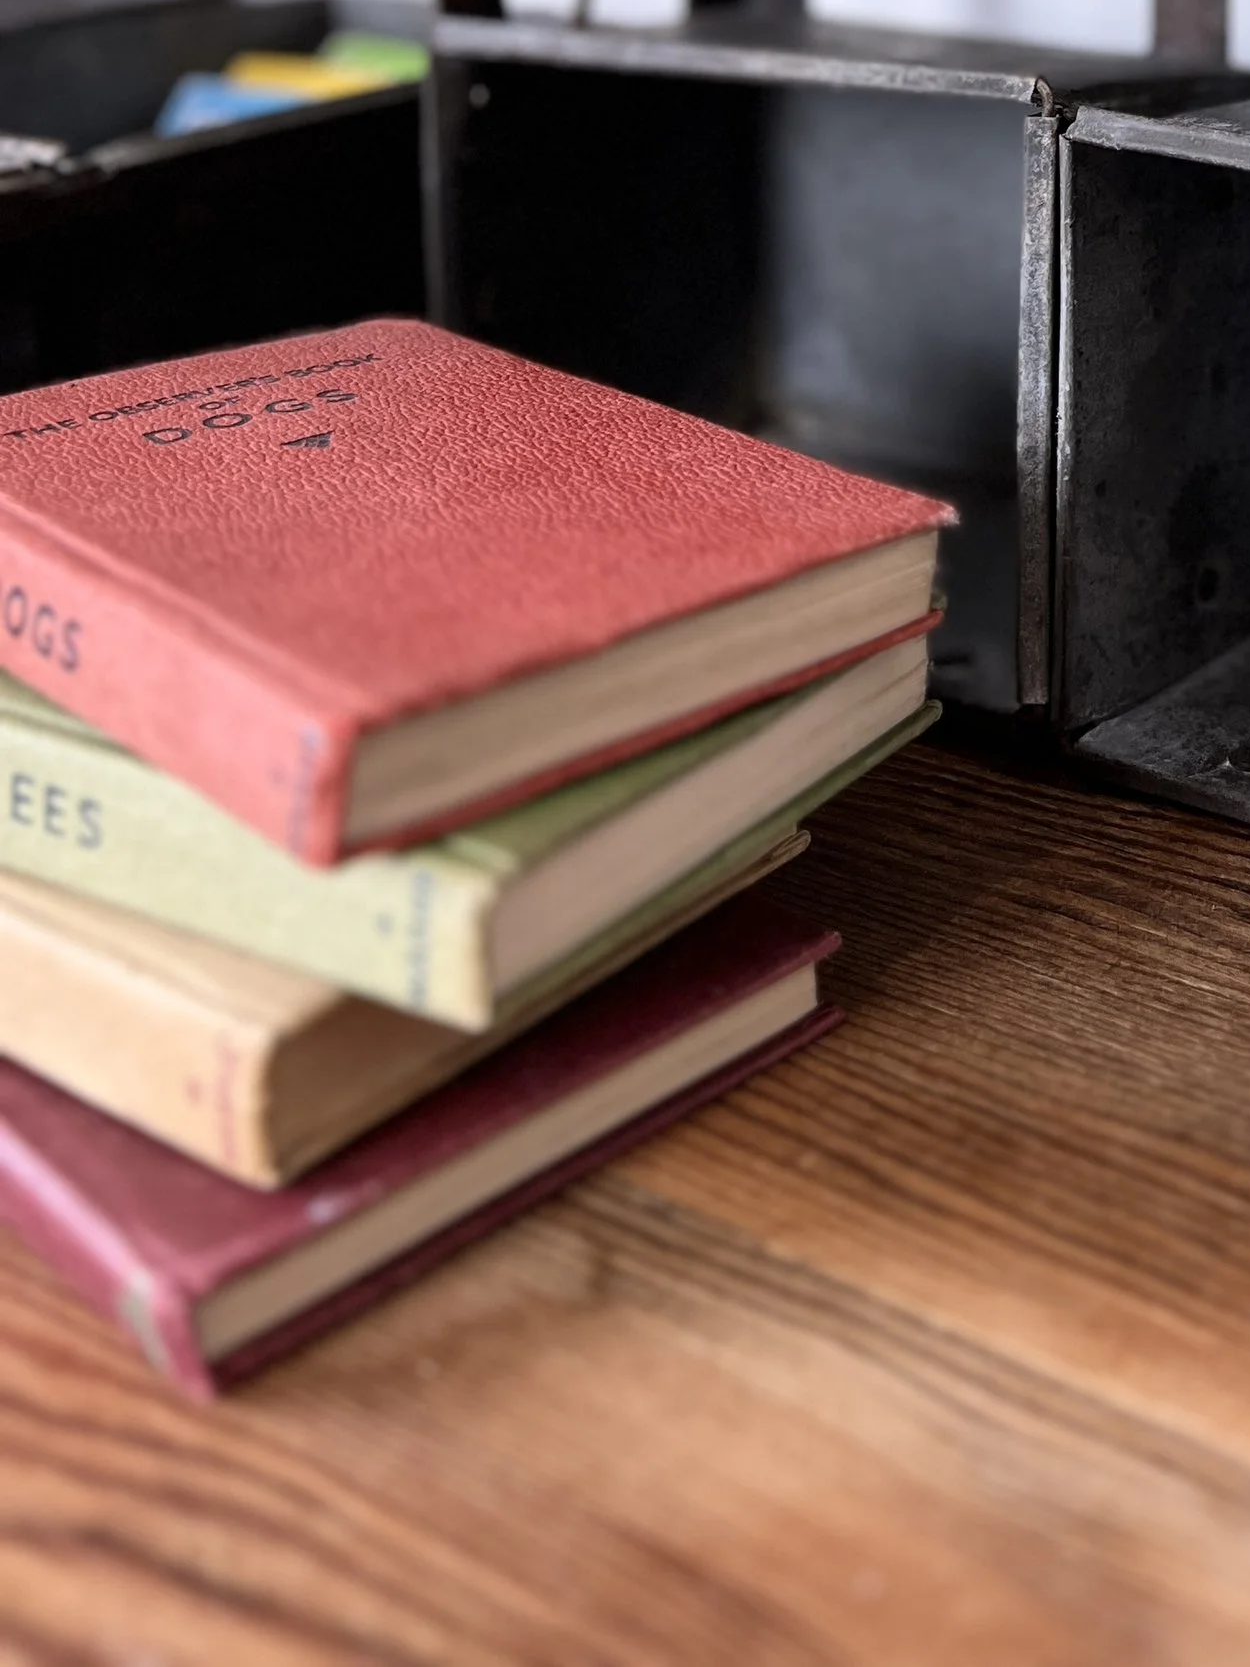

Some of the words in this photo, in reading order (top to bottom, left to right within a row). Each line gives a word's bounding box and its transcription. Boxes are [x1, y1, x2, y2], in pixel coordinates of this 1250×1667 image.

[4, 419, 82, 438] THE
[284, 353, 382, 378] BOOK
[142, 389, 357, 445] DOGS
[199, 396, 240, 410] OF
[0, 582, 82, 674] OGS
